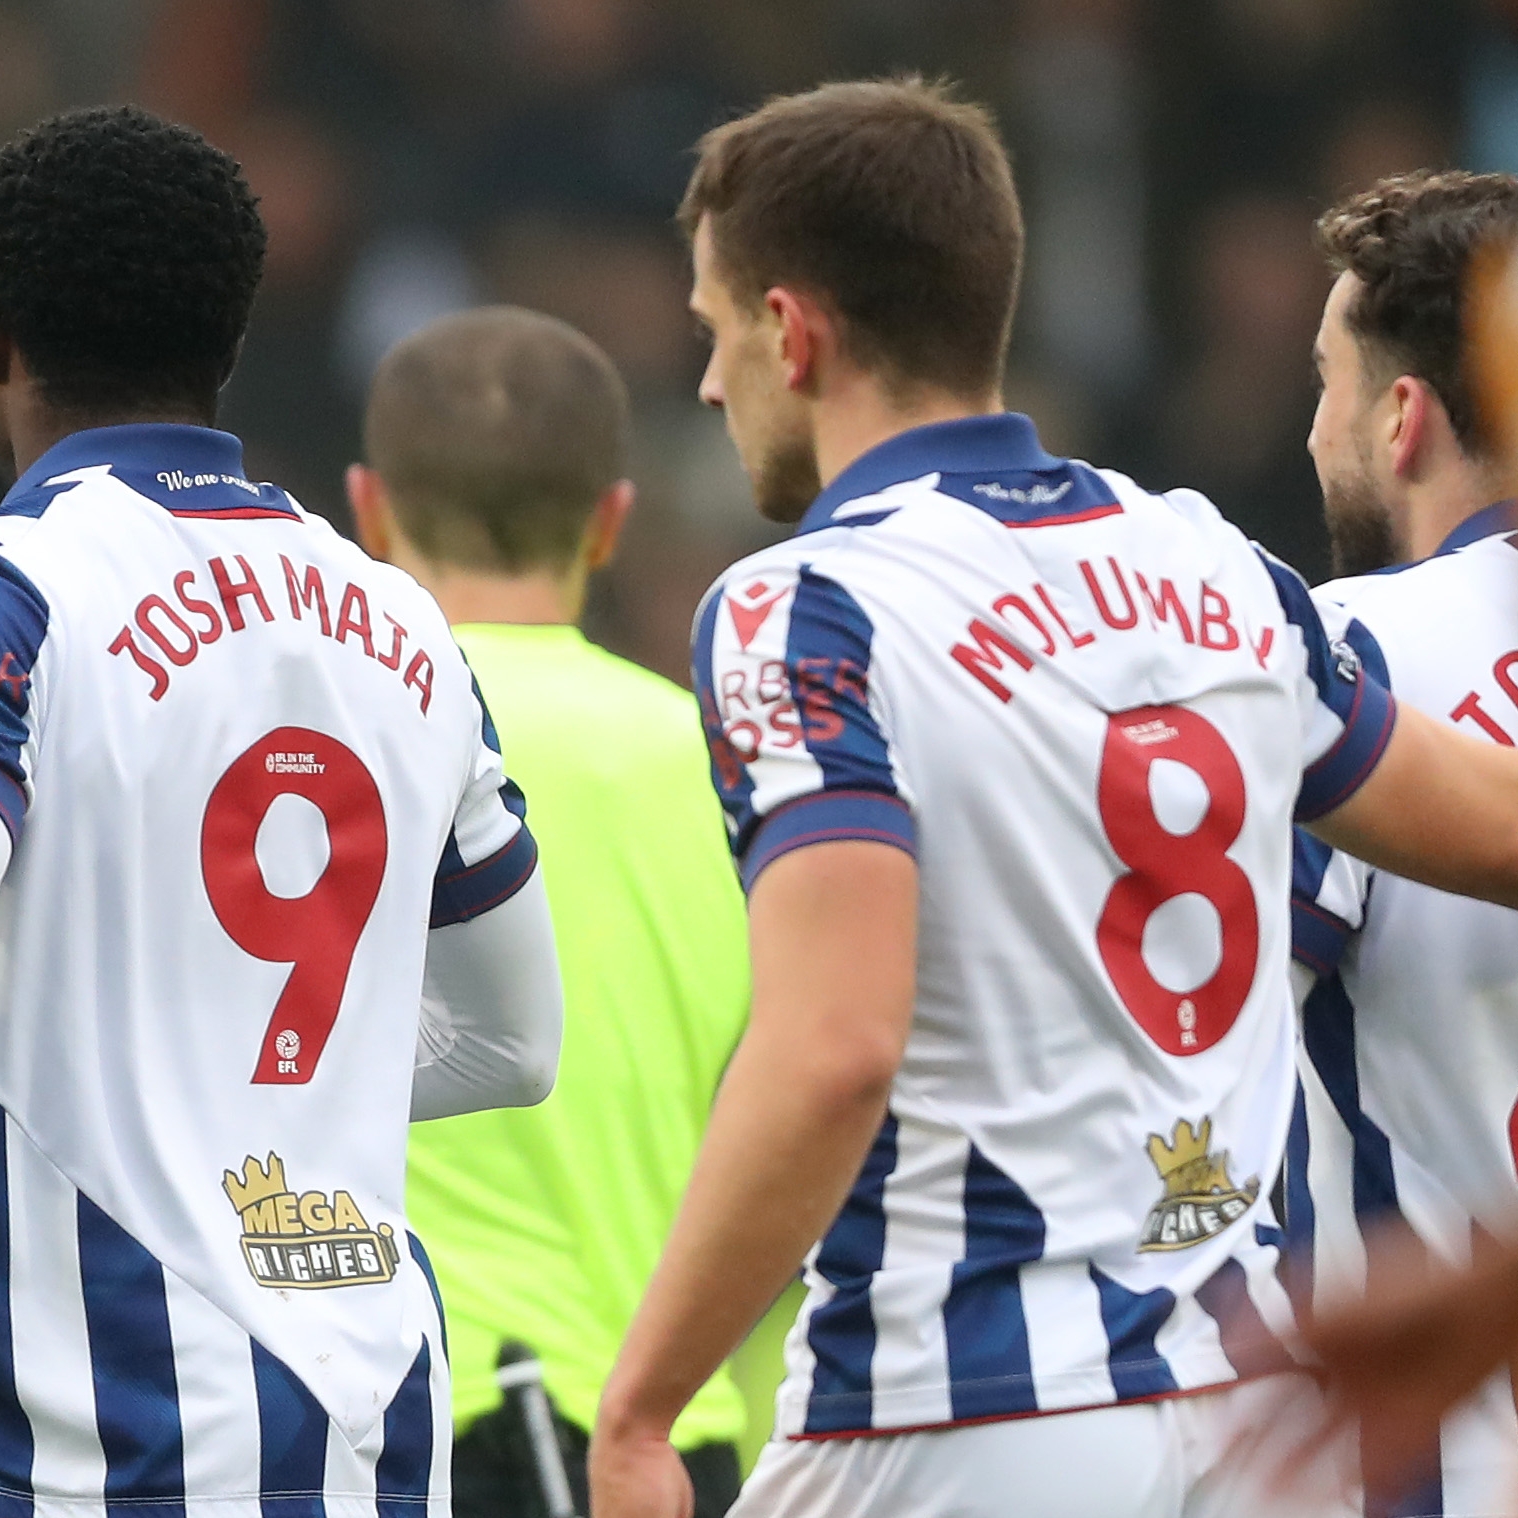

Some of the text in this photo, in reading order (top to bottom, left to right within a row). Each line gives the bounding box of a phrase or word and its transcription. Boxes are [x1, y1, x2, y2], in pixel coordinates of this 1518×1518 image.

[156, 470, 193, 491] We
[195, 474, 219, 486] are
[107, 553, 434, 718] JOSH MAJA
[298, 753, 315, 763] THE
[1096, 705, 1258, 1056] 8
[200, 726, 388, 1084] 9
[277, 1060, 299, 1074] EFL
[243, 1190, 370, 1235] MEGA
[249, 1242, 380, 1282] RICHES
